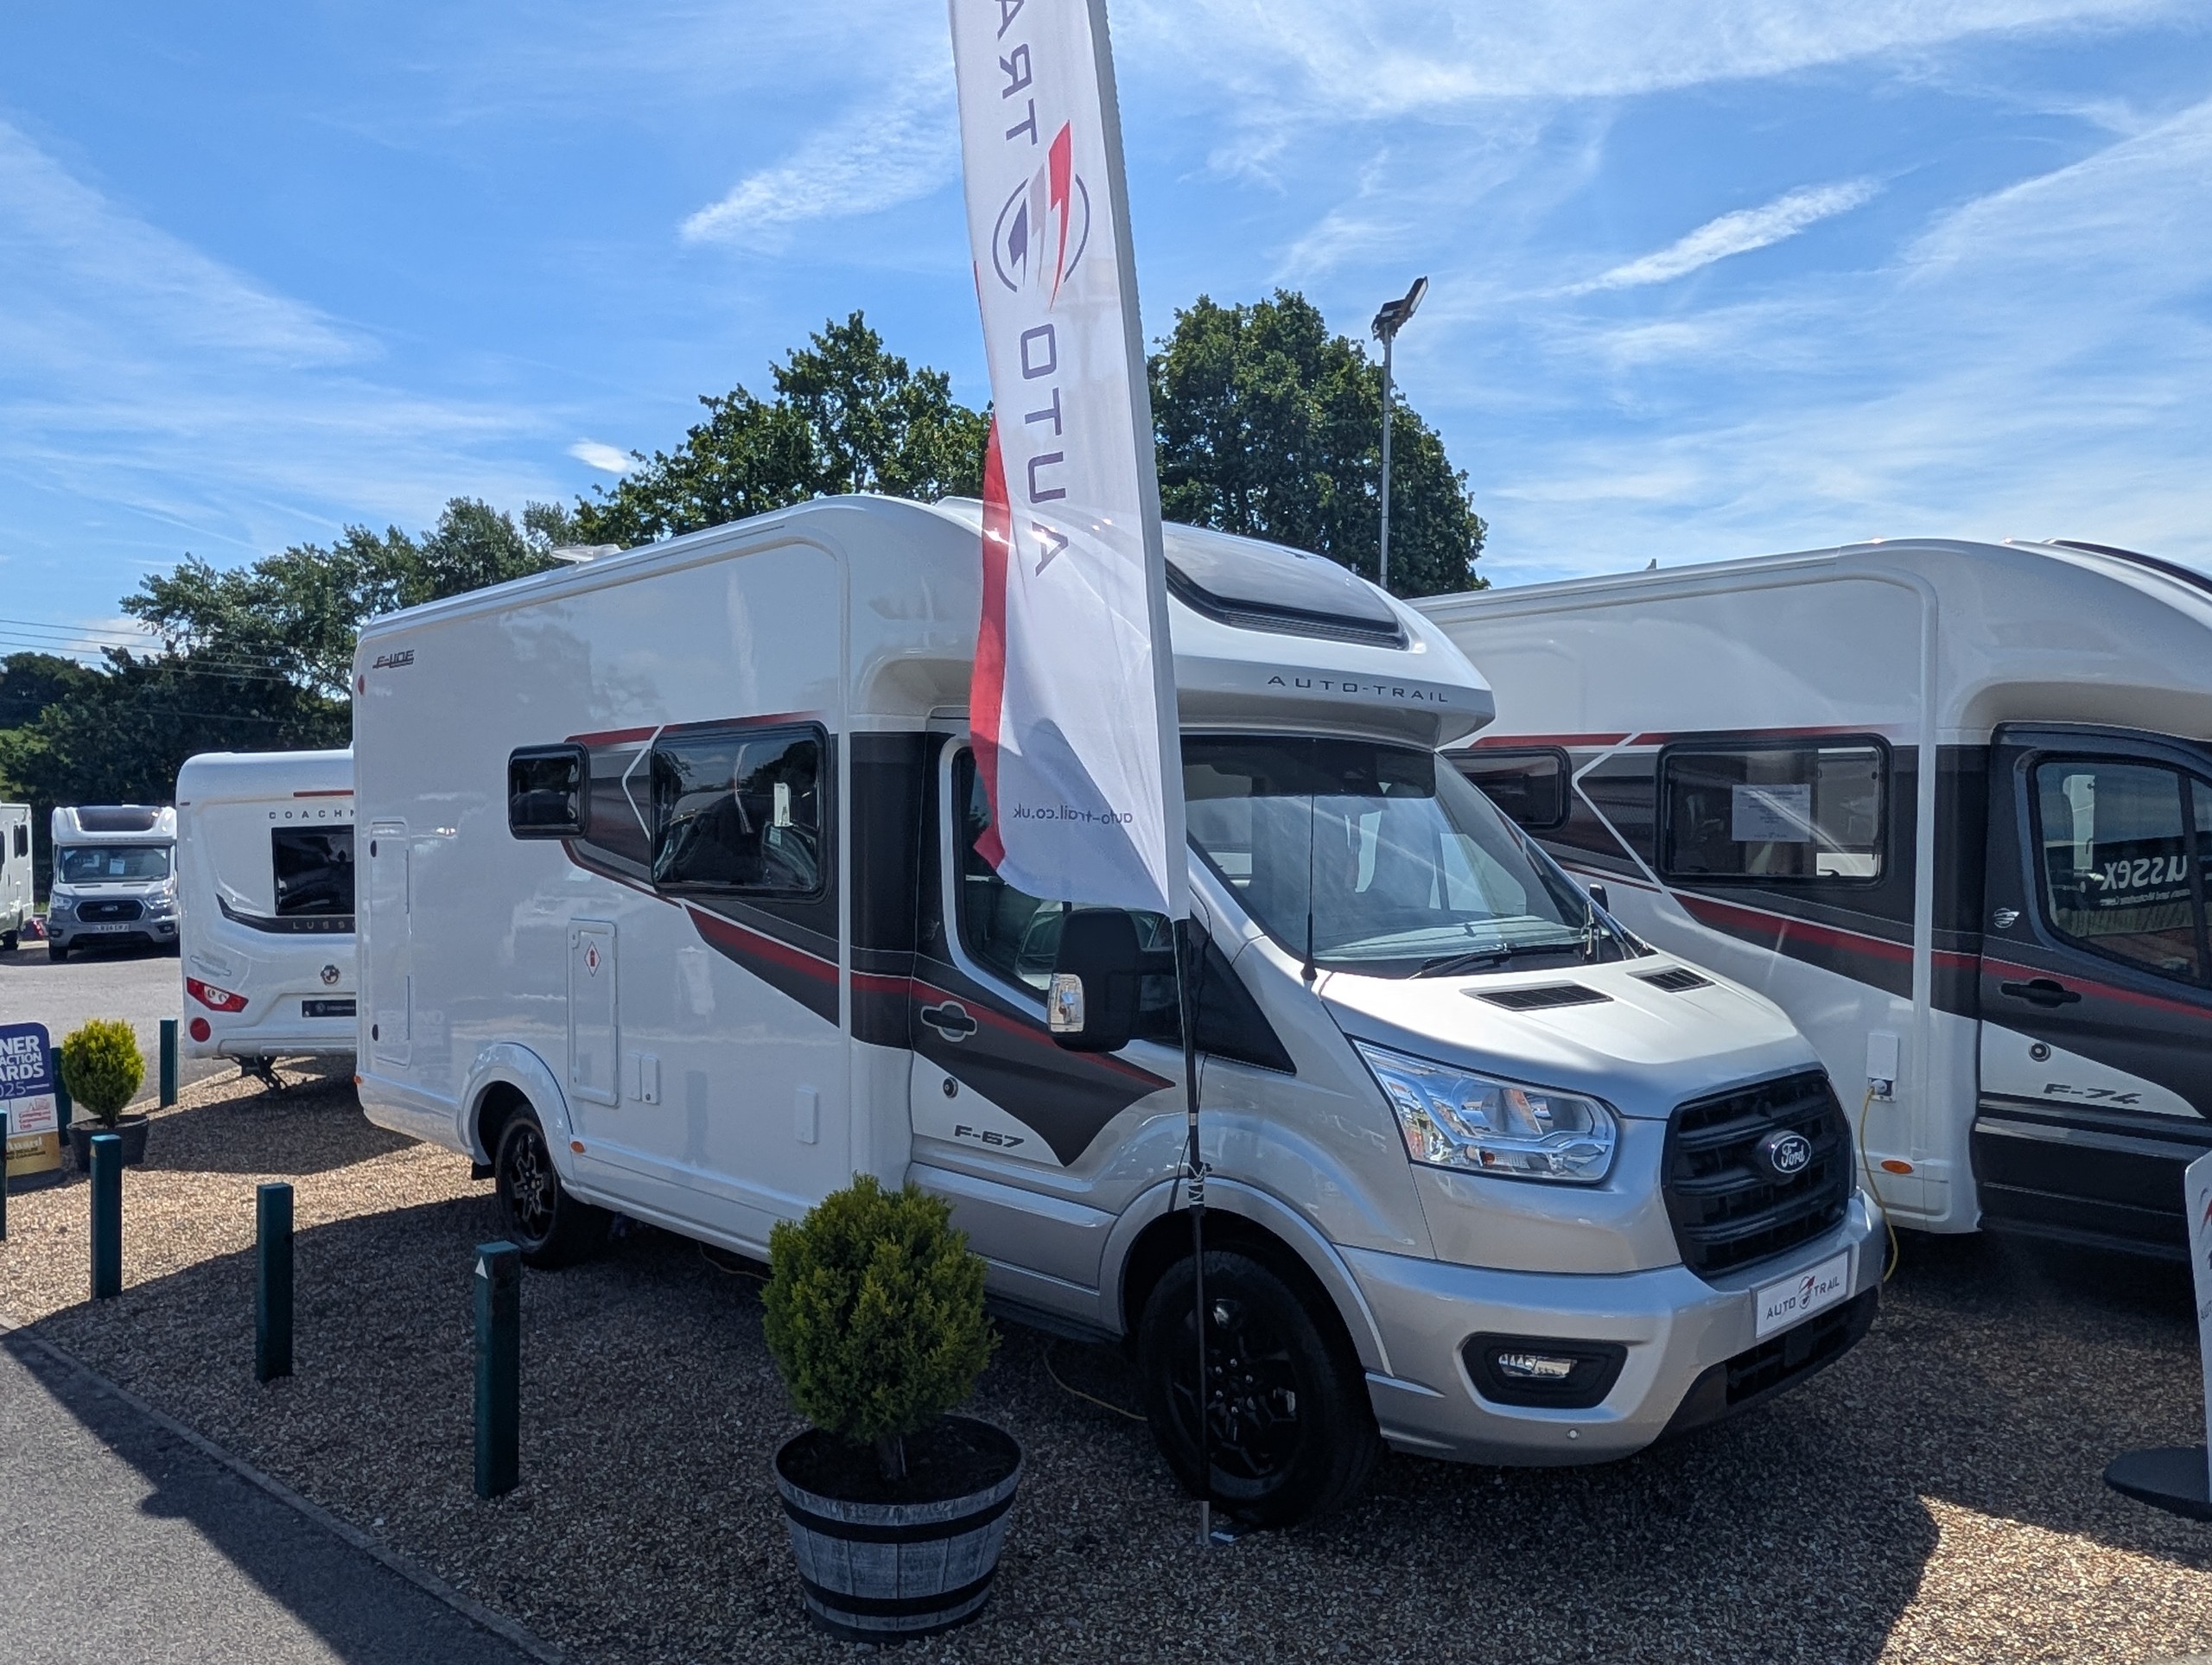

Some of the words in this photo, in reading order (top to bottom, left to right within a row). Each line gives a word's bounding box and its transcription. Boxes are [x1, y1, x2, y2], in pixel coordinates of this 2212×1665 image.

[1268, 676, 1448, 702] AUTO-TRAIL
[2044, 1084, 2142, 1104] F-74
[955, 1125, 1025, 1147] F-67
[1781, 1141, 1805, 1168] Ford
[1766, 1297, 1796, 1319] AUTO
[1814, 1276, 1840, 1297] TRAIL
